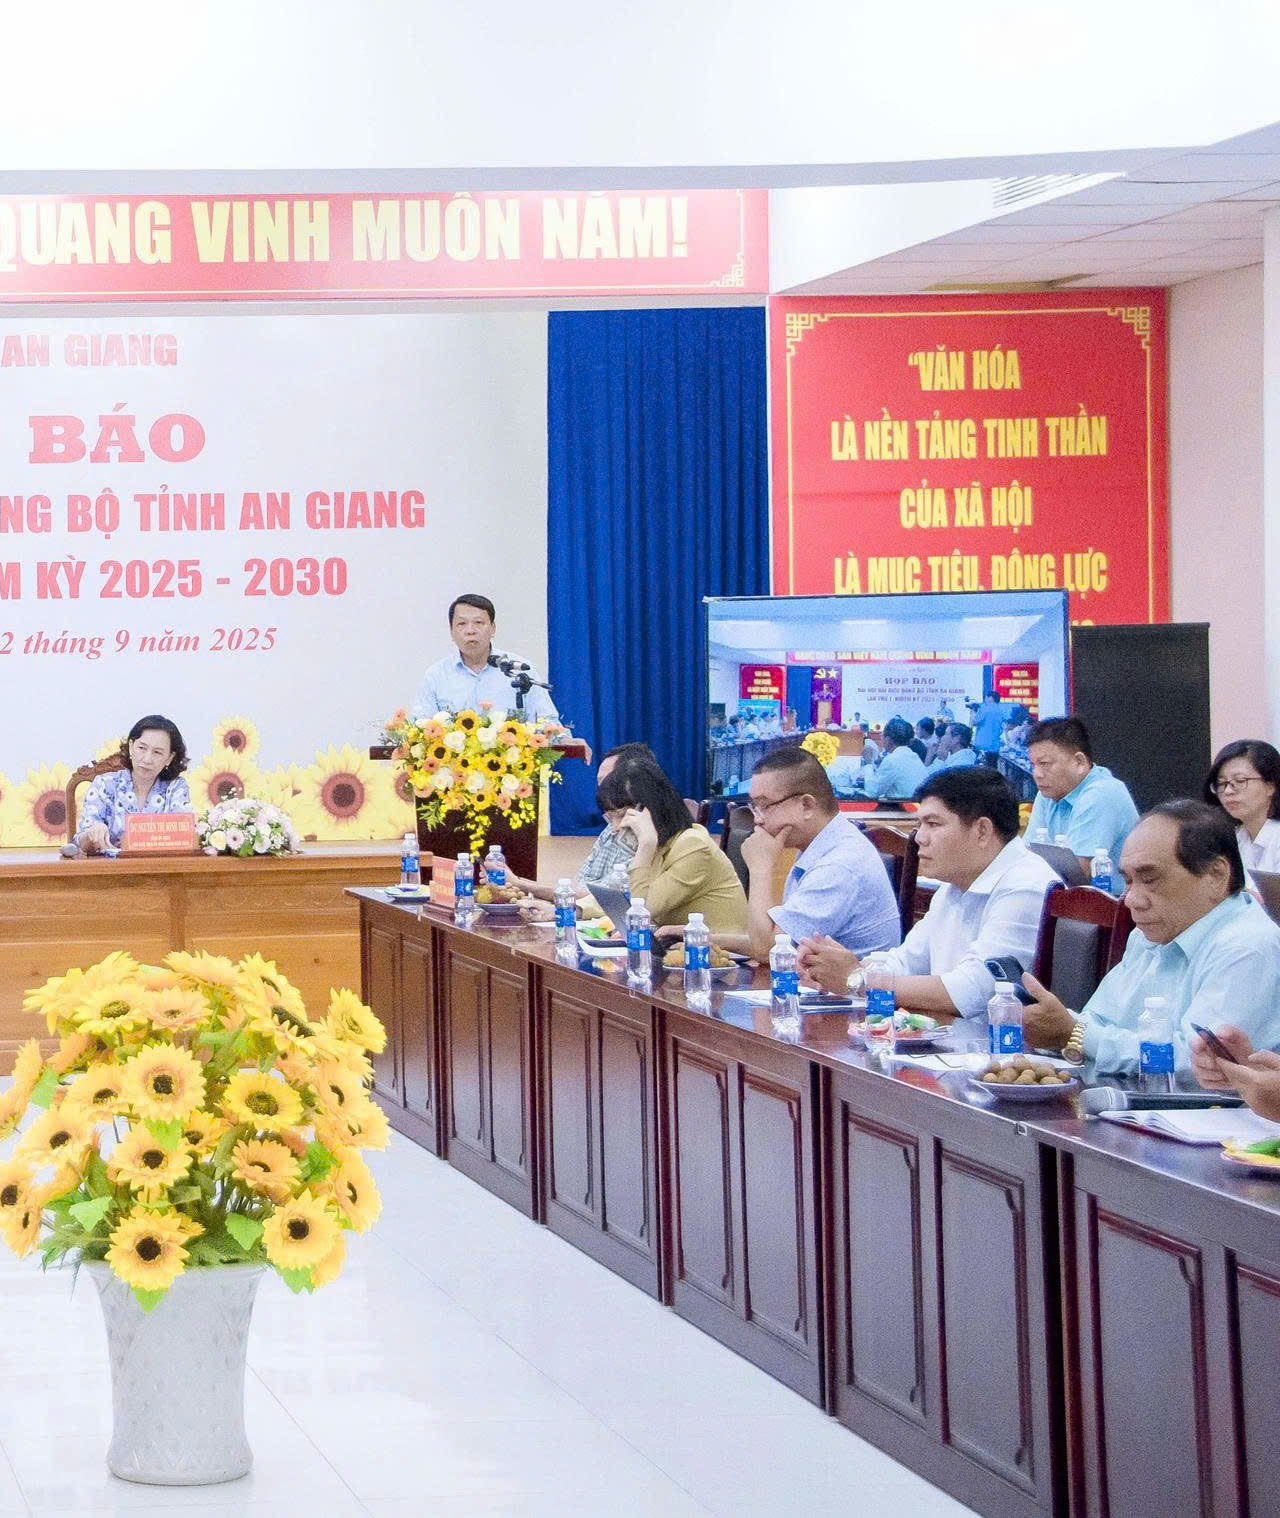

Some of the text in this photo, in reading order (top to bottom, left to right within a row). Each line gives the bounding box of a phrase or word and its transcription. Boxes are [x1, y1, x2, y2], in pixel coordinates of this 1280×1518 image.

[191, 201, 329, 263] VINH
[352, 192, 520, 262] MUÔN
[0, 334, 48, 368] AN
[64, 332, 178, 368] GIANG
[973, 345, 1020, 389] HÓA
[28, 403, 206, 464] BÁO
[831, 404, 1106, 461] LÀ NỀN TẢNG TINH THẦN
[67, 488, 120, 540] BỘ
[133, 485, 226, 532] TỈNH
[239, 491, 292, 531] AN
[305, 489, 427, 531] GIANG
[900, 479, 1032, 533] CỦA XÃ HỘI
[36, 555, 86, 600] KỲ
[99, 558, 203, 599] 2025
[243, 556, 348, 597] 2030
[834, 552, 862, 594] LÀ
[1064, 548, 1107, 599] LỰC
[24, 632, 104, 660] tháng
[115, 629, 130, 652] 9
[139, 628, 200, 653] năm
[210, 627, 277, 652] 2025
